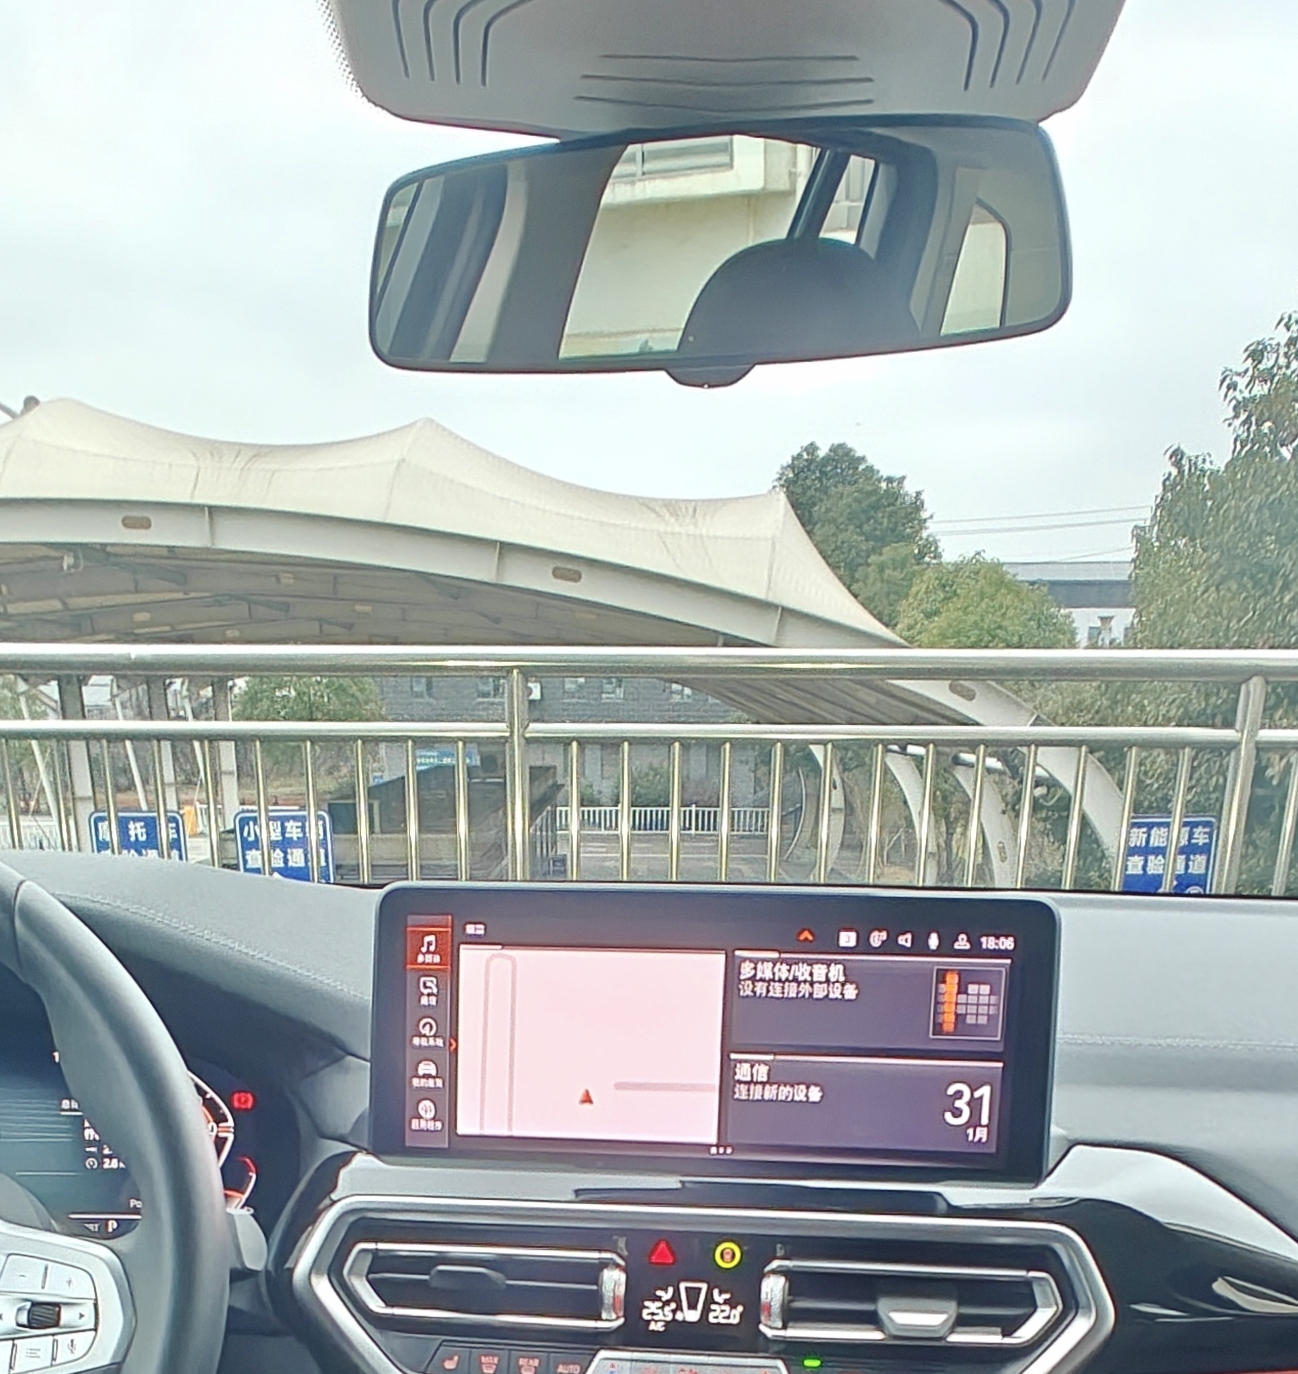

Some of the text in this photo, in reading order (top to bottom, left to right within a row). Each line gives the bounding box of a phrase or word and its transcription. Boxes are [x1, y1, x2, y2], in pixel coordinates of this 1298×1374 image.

[740, 960, 845, 982] 多媒体/收音机
[739, 980, 858, 1000] 没有连接外部设备
[735, 1063, 770, 1082] 通信
[734, 1083, 823, 1102] 连接新的设备
[943, 1083, 993, 1126] 31
[966, 1127, 988, 1143] 1月
[557, 1363, 581, 1374] AUTO
